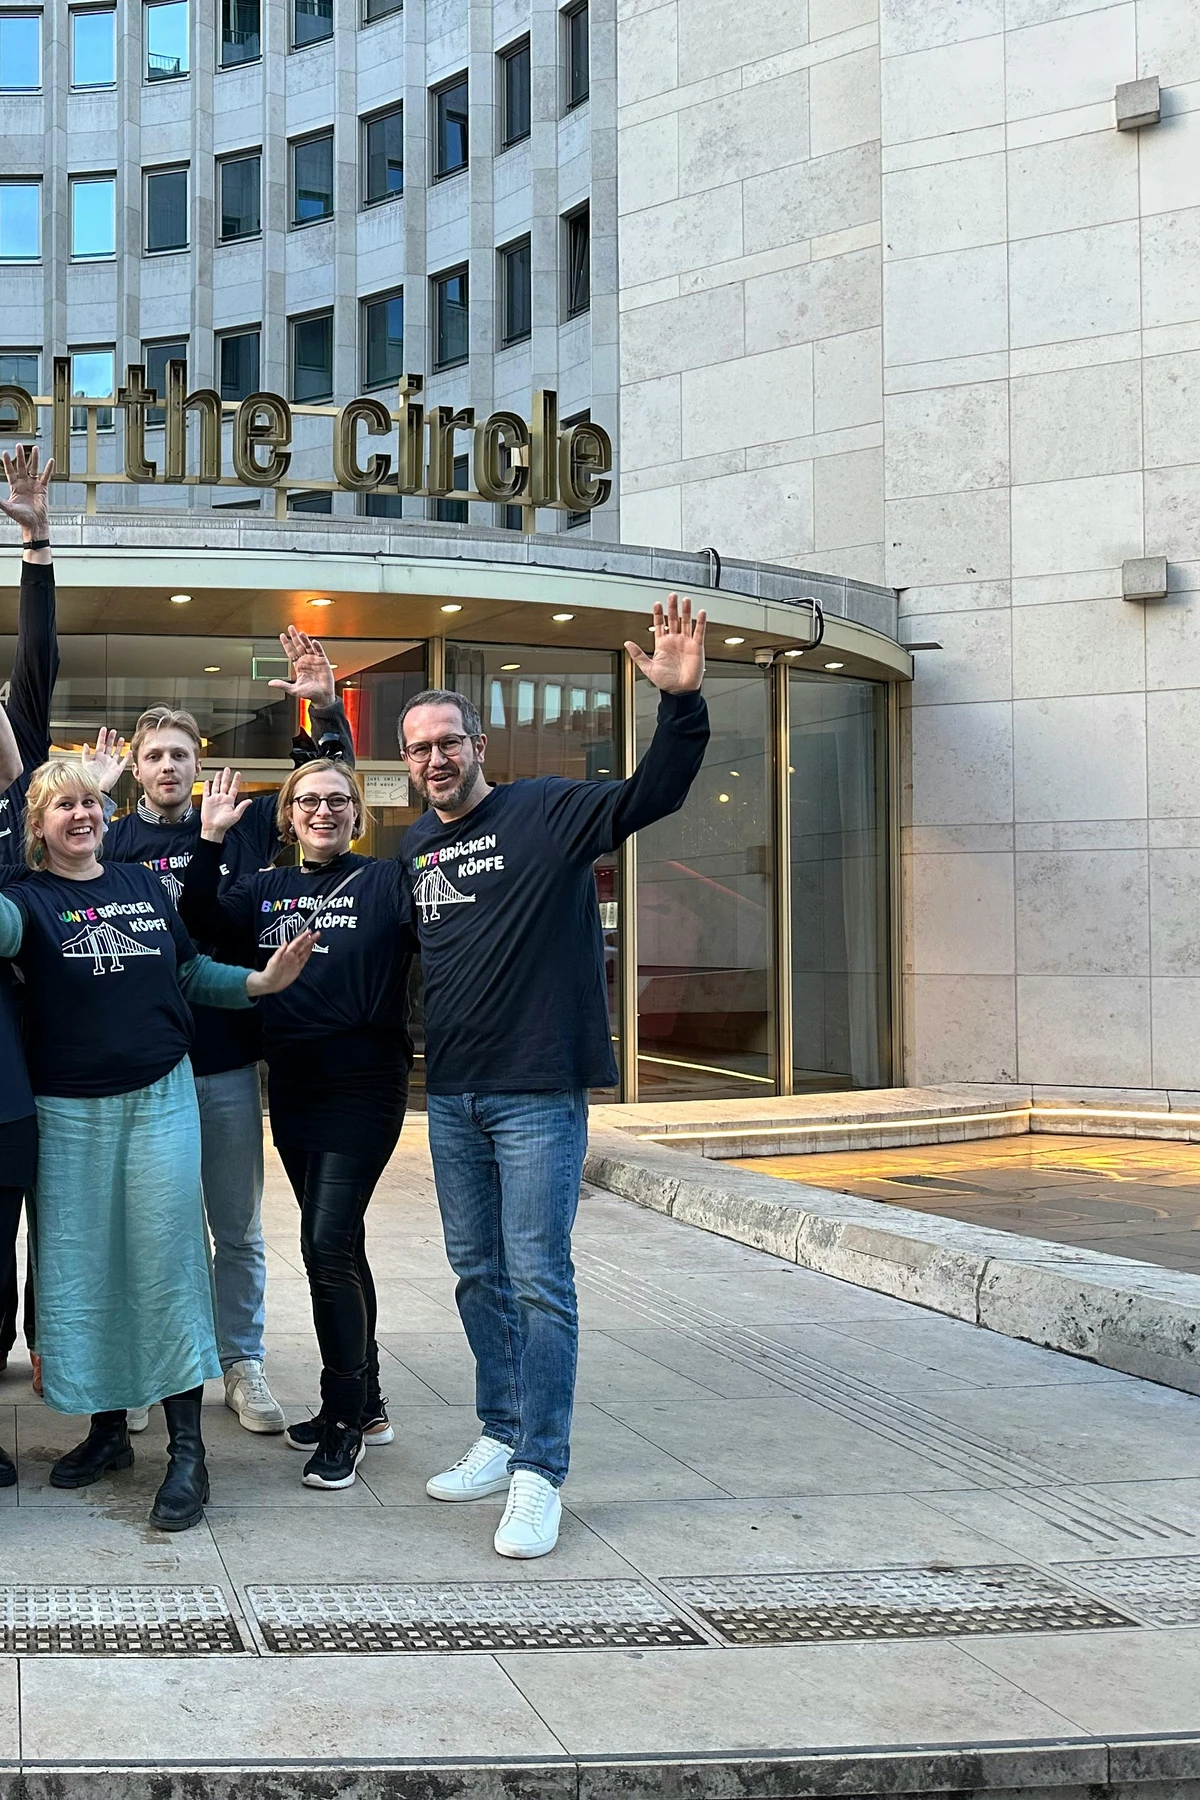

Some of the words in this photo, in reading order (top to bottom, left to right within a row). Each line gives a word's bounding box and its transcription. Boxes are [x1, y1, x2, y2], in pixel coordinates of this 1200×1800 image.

[118, 358, 292, 486] the
[333, 373, 612, 510] circle
[457, 855, 505, 878] KÖPFE
[314, 912, 358, 930] KÖPFE
